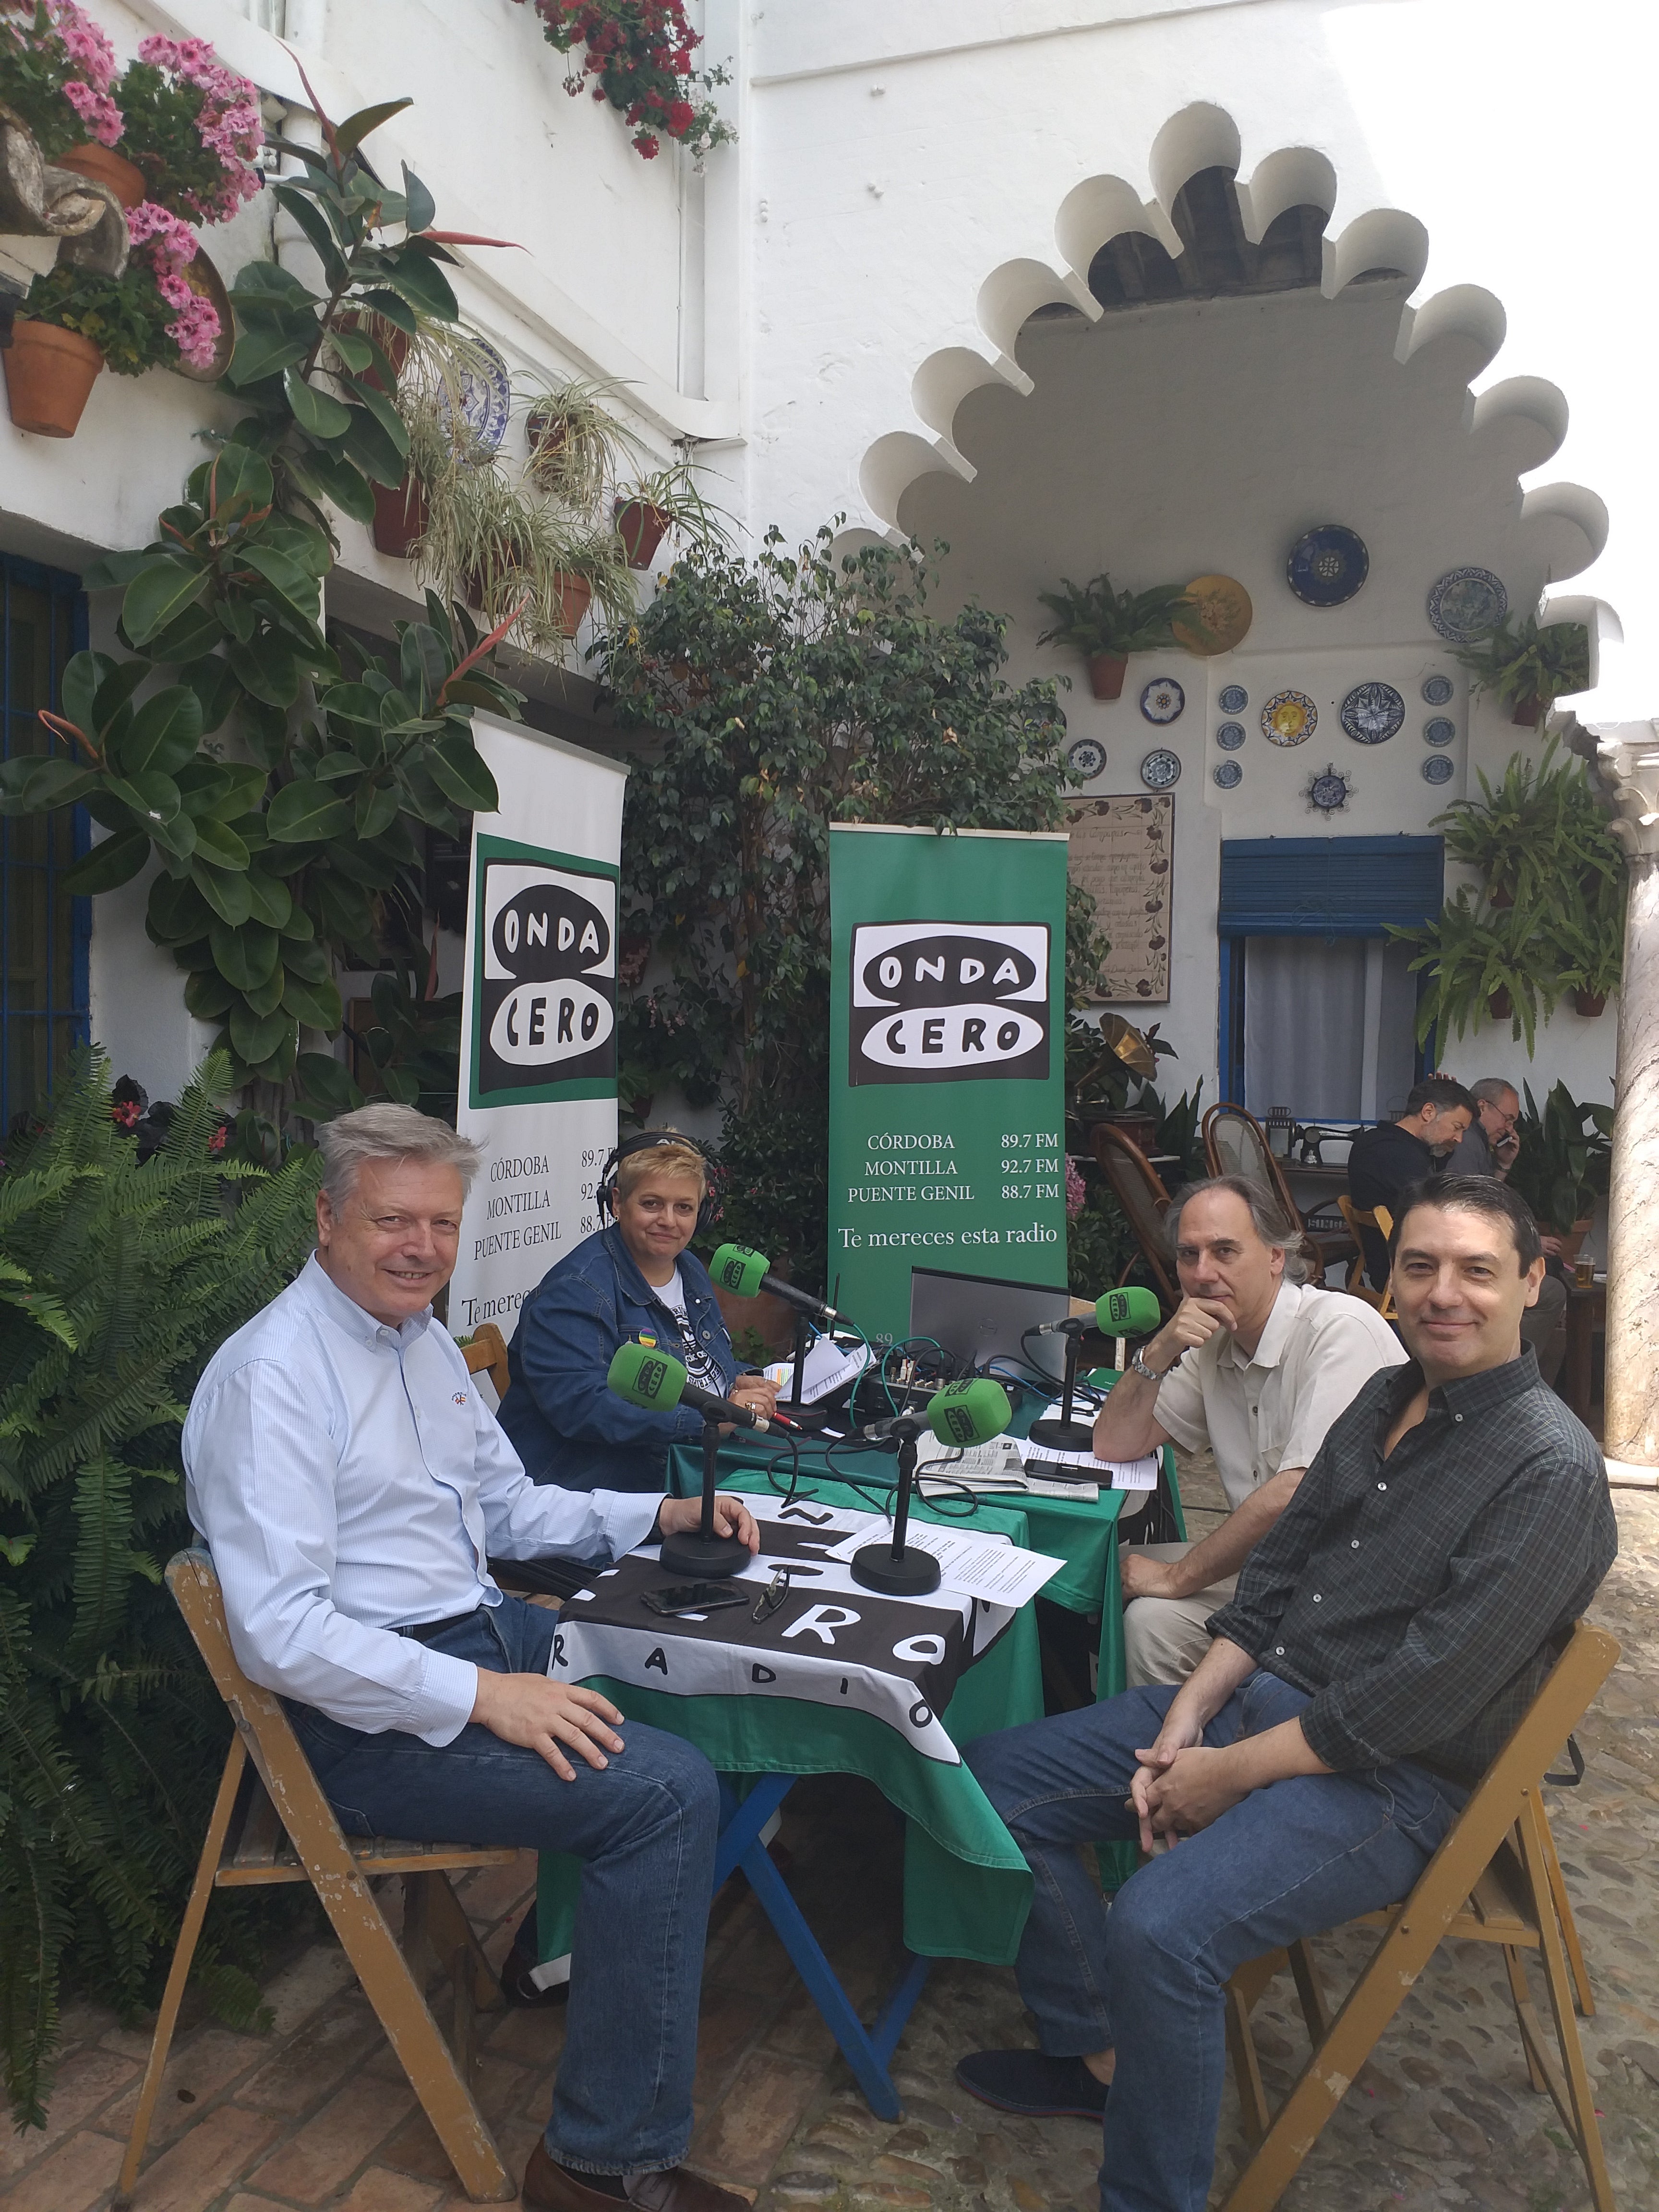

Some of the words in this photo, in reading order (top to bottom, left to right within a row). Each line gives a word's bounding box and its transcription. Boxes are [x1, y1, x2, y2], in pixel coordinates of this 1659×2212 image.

[505, 909, 600, 955] ONDA
[879, 955, 1020, 988] ONDA
[506, 997, 600, 1047] CERO
[885, 1017, 1021, 1055] CERO
[867, 1132, 955, 1150] CÓRDOBA
[1001, 1133, 1032, 1148] 89.7
[1035, 1133, 1058, 1148] FM
[490, 1154, 549, 1183] CÓRDOBA
[581, 1149, 604, 1167] 89.7
[864, 1160, 958, 1176] MONTILLA
[1001, 1159, 1032, 1174] 92.7
[1035, 1158, 1059, 1173] FM
[487, 1190, 551, 1221] MONTILLA
[847, 1187, 917, 1203] PUENTE
[921, 1185, 975, 1201] GENIL
[1001, 1184, 1032, 1200] 88.7
[1035, 1184, 1059, 1198] FM
[474, 1230, 522, 1261] PUENTE
[523, 1221, 562, 1249] GENIL
[838, 1227, 862, 1249] Te
[867, 1230, 954, 1248] mereces
[961, 1226, 1000, 1245] esta
[1006, 1222, 1058, 1243] radio
[461, 1297, 481, 1327] Te
[649, 1367, 661, 1391] CERO
